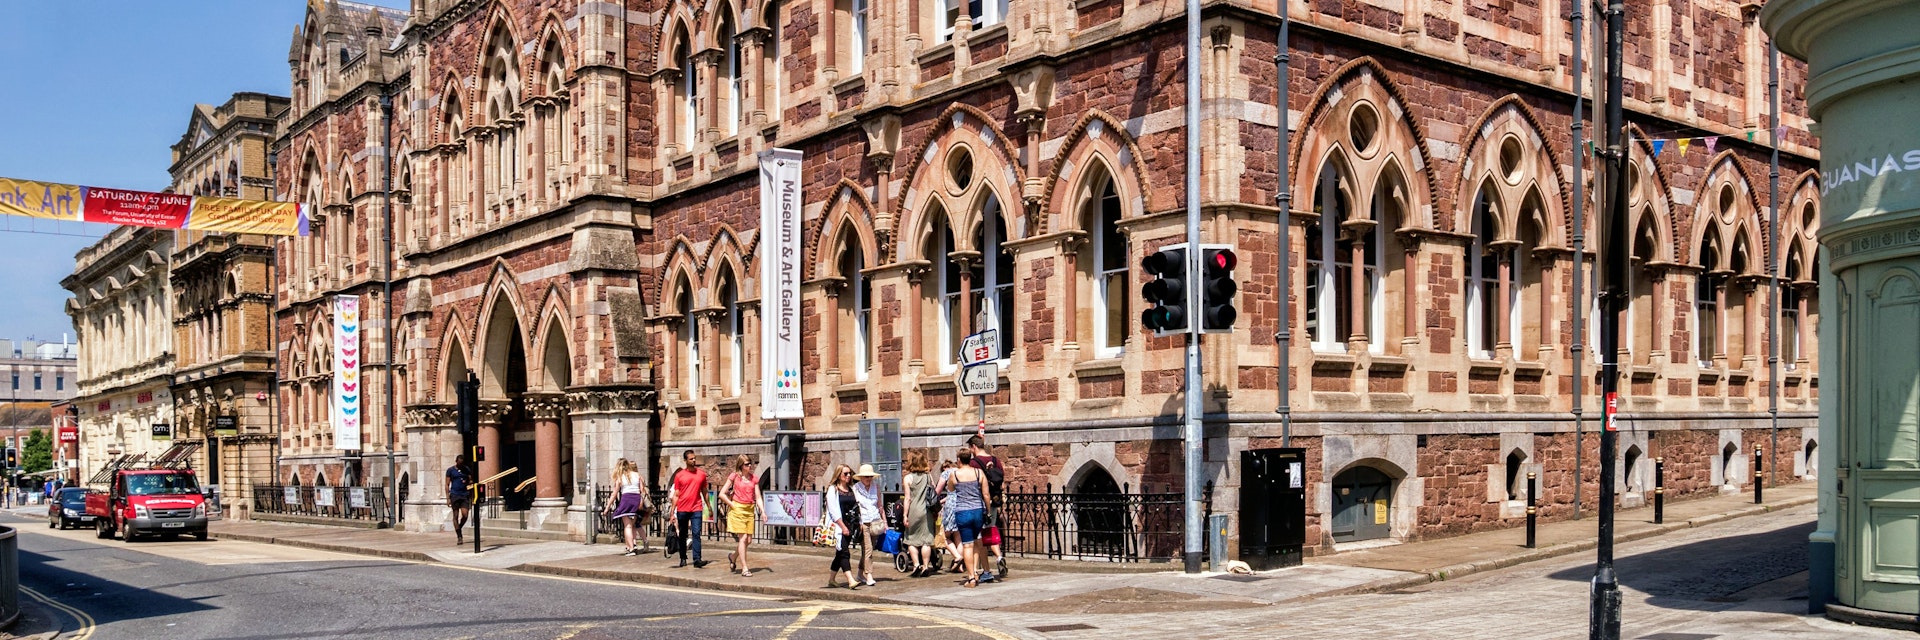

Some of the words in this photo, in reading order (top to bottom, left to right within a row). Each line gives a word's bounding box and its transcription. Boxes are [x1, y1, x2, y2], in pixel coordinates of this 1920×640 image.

[90, 190, 147, 203] SATURDAY
[149, 196, 160, 204] 17
[160, 196, 188, 206] JUNE
[224, 205, 253, 214] FAMILY
[782, 180, 795, 243] Museum
[130, 211, 155, 220] University
[208, 212, 234, 220] Create
[253, 215, 285, 223] Discover
[783, 246, 793, 258] &
[782, 261, 793, 285] Art
[780, 289, 794, 342] Gallery
[969, 336, 995, 347] Stations
[977, 369, 987, 378] All
[970, 381, 995, 391] Routes
